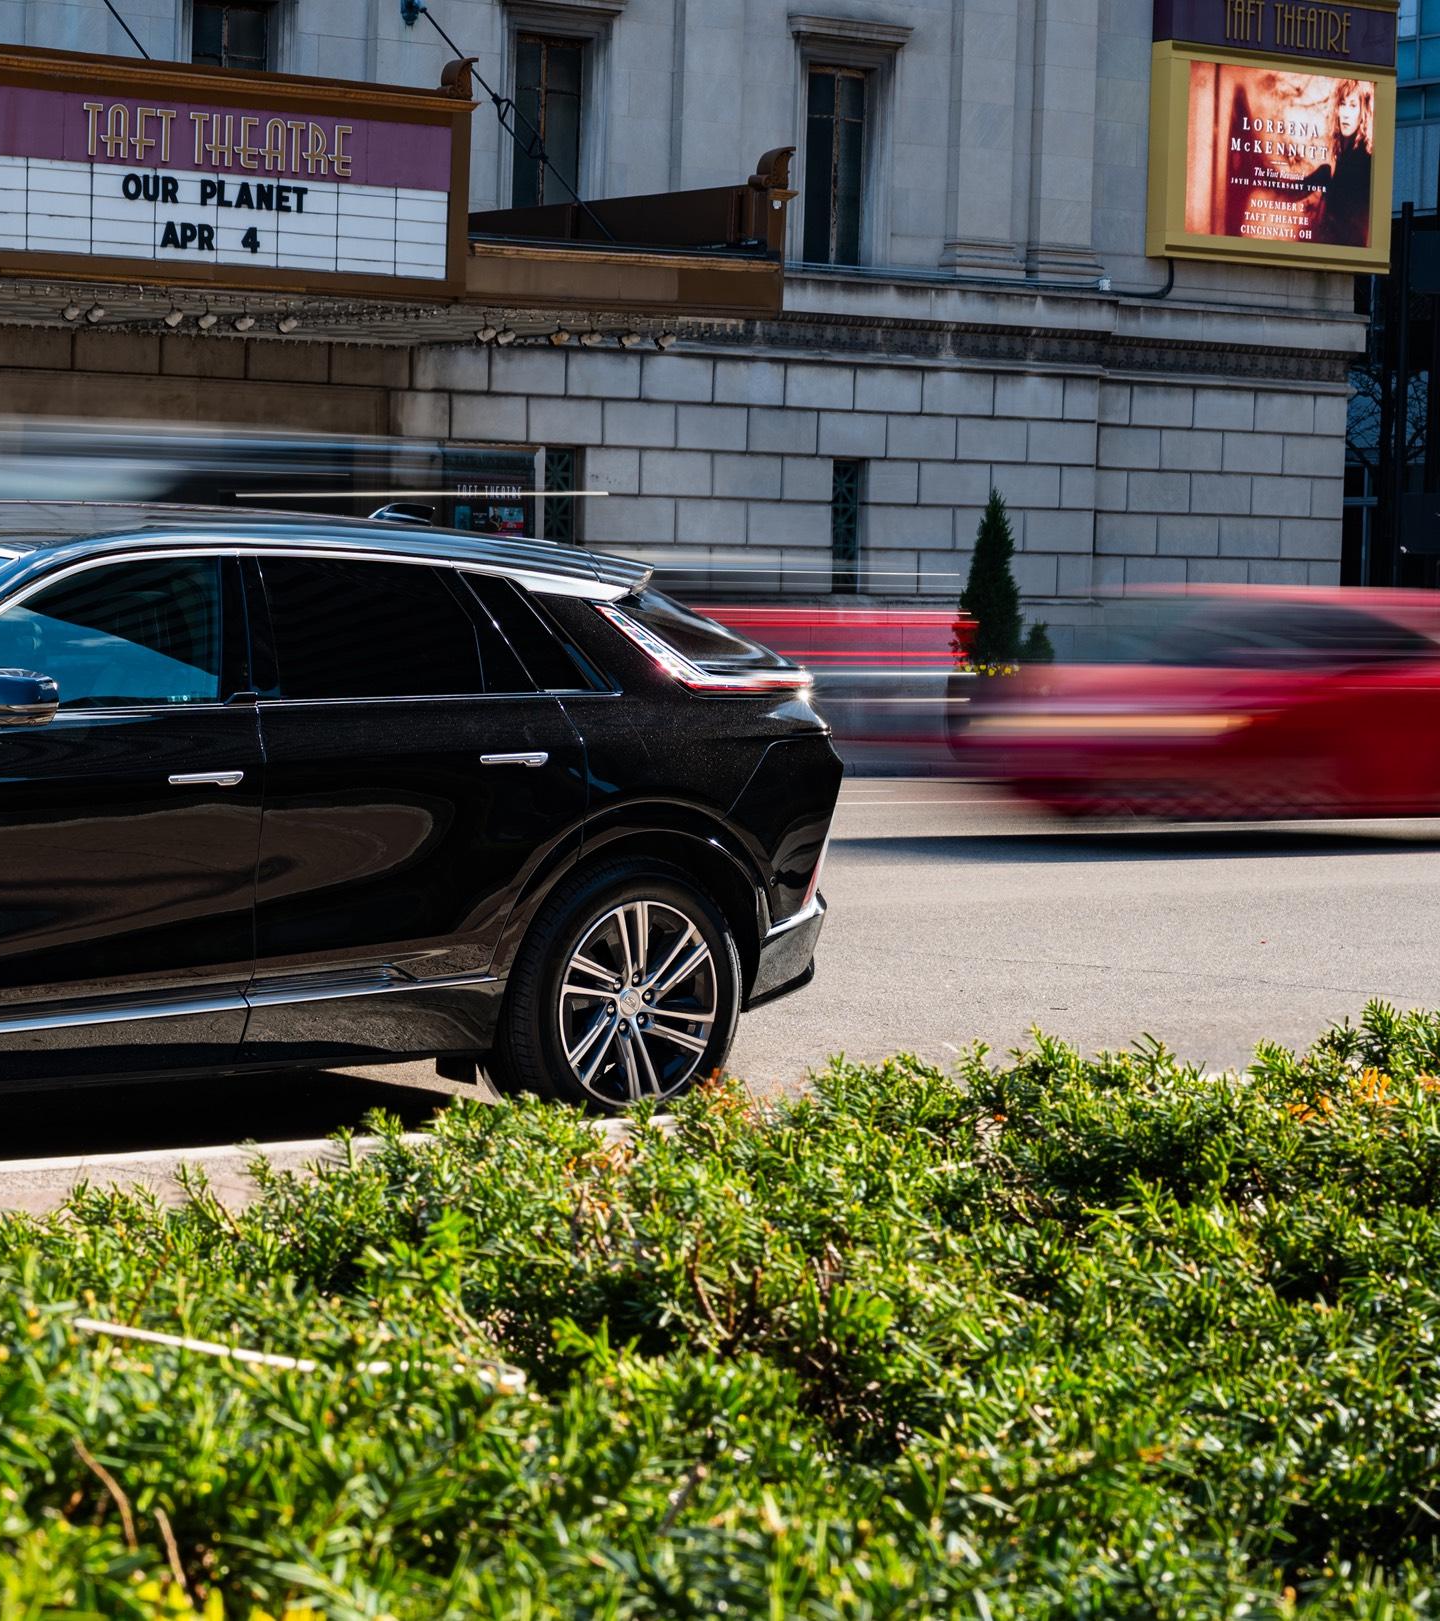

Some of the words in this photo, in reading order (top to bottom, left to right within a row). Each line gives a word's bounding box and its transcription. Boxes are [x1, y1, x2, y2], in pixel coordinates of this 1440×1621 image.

[1225, 0, 1265, 42] TAFT
[1274, 3, 1351, 54] THEATRE
[1243, 117, 1319, 138] LOREENA
[83, 102, 176, 162] TAFT
[190, 111, 353, 177] THEATRE
[1231, 137, 1328, 160] McKENNITT
[1254, 167, 1265, 177] The
[122, 173, 179, 204] OUR
[200, 180, 308, 213] PLANET
[1252, 180, 1303, 190] ANNIVERSARY
[1251, 199, 1300, 211] NOVEMBER
[1245, 212, 1267, 221] TAFT
[1270, 213, 1309, 225] THEATRE
[161, 221, 215, 251] APR
[241, 226, 260, 254] 4
[1241, 224, 1296, 239] CINCINNATI,
[1299, 230, 1312, 239] OH
